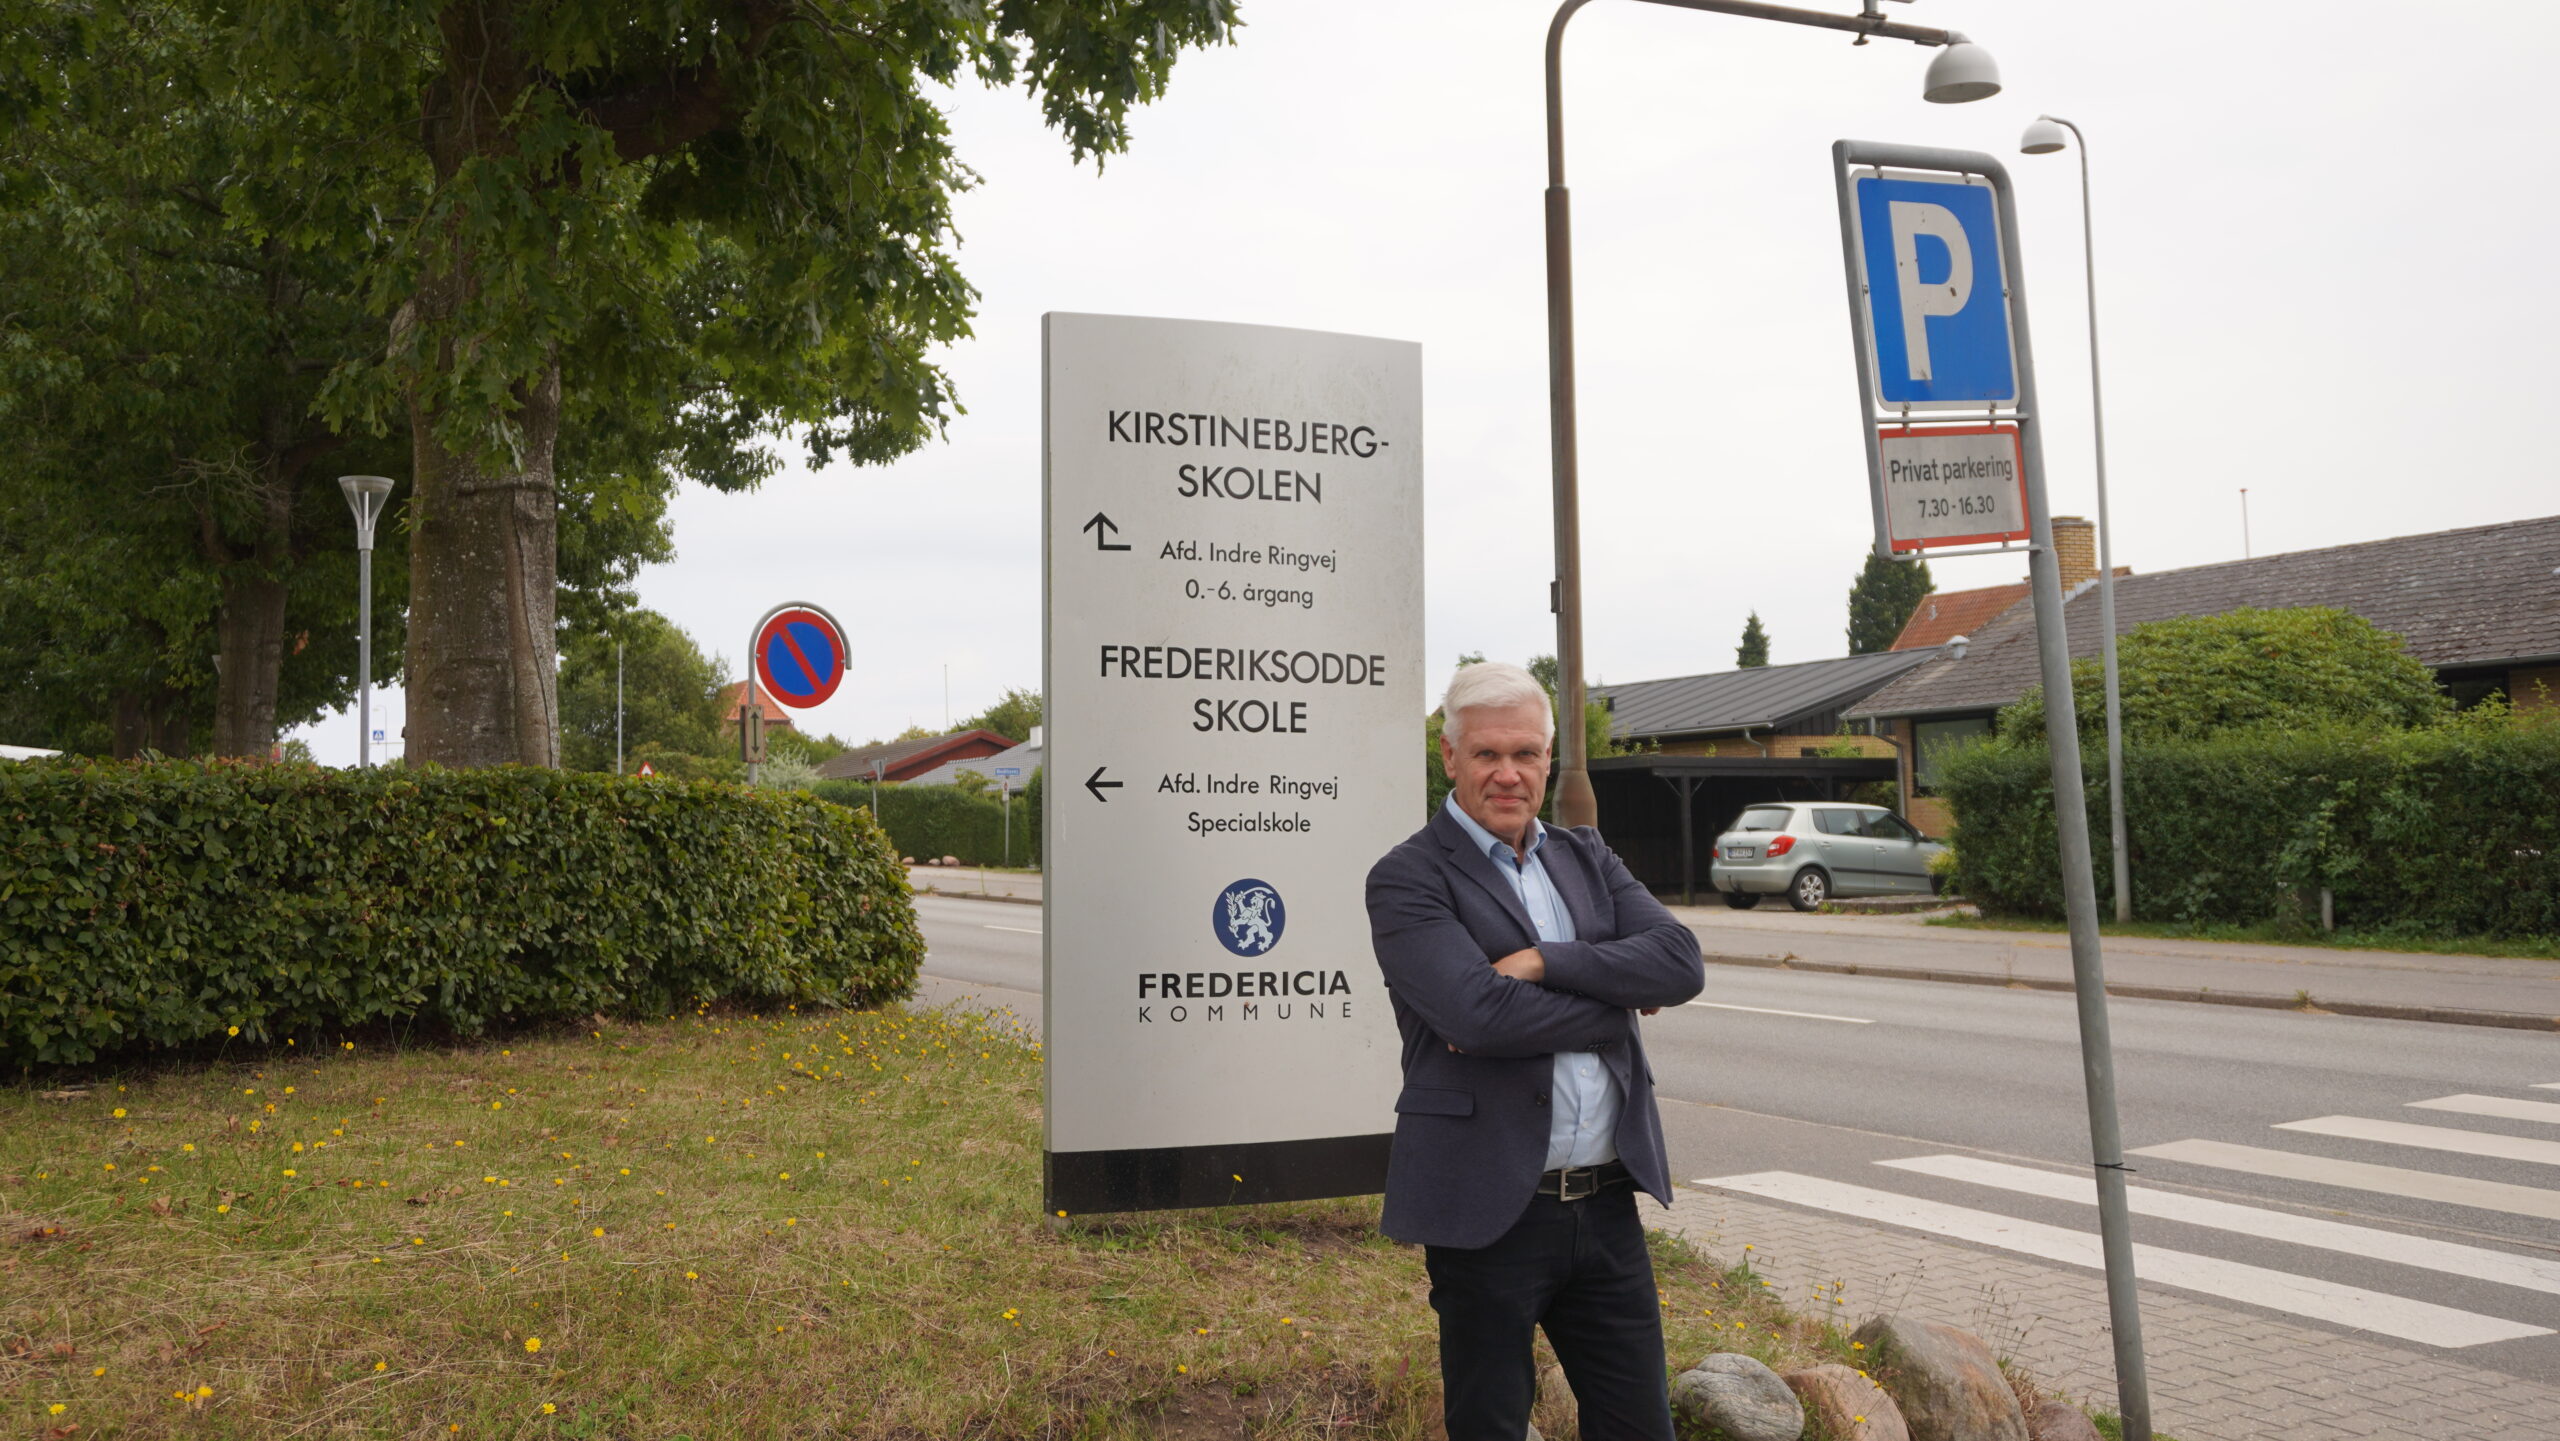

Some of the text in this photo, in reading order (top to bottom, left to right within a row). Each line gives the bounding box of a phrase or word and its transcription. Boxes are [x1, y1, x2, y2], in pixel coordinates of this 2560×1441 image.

[1889, 200, 1974, 381] P
[1109, 410, 1390, 459] KIRSTINEBJERG-
[1177, 463, 1321, 504] SKOLEN
[1889, 455, 2013, 485] Privat parkering
[1159, 540, 1336, 574] Afd. Indre Ringvej
[1242, 582, 1314, 609] årgang
[1100, 644, 1385, 686] FREDERIKSODDE
[1192, 698, 1307, 734] SKOLE
[1158, 772, 1339, 800] Afd. Indre Ringvej
[1187, 811, 1311, 838] Specialskole
[1138, 970, 1352, 999] FREDERICIA
[1139, 1001, 1352, 1023] KOMMUNE
